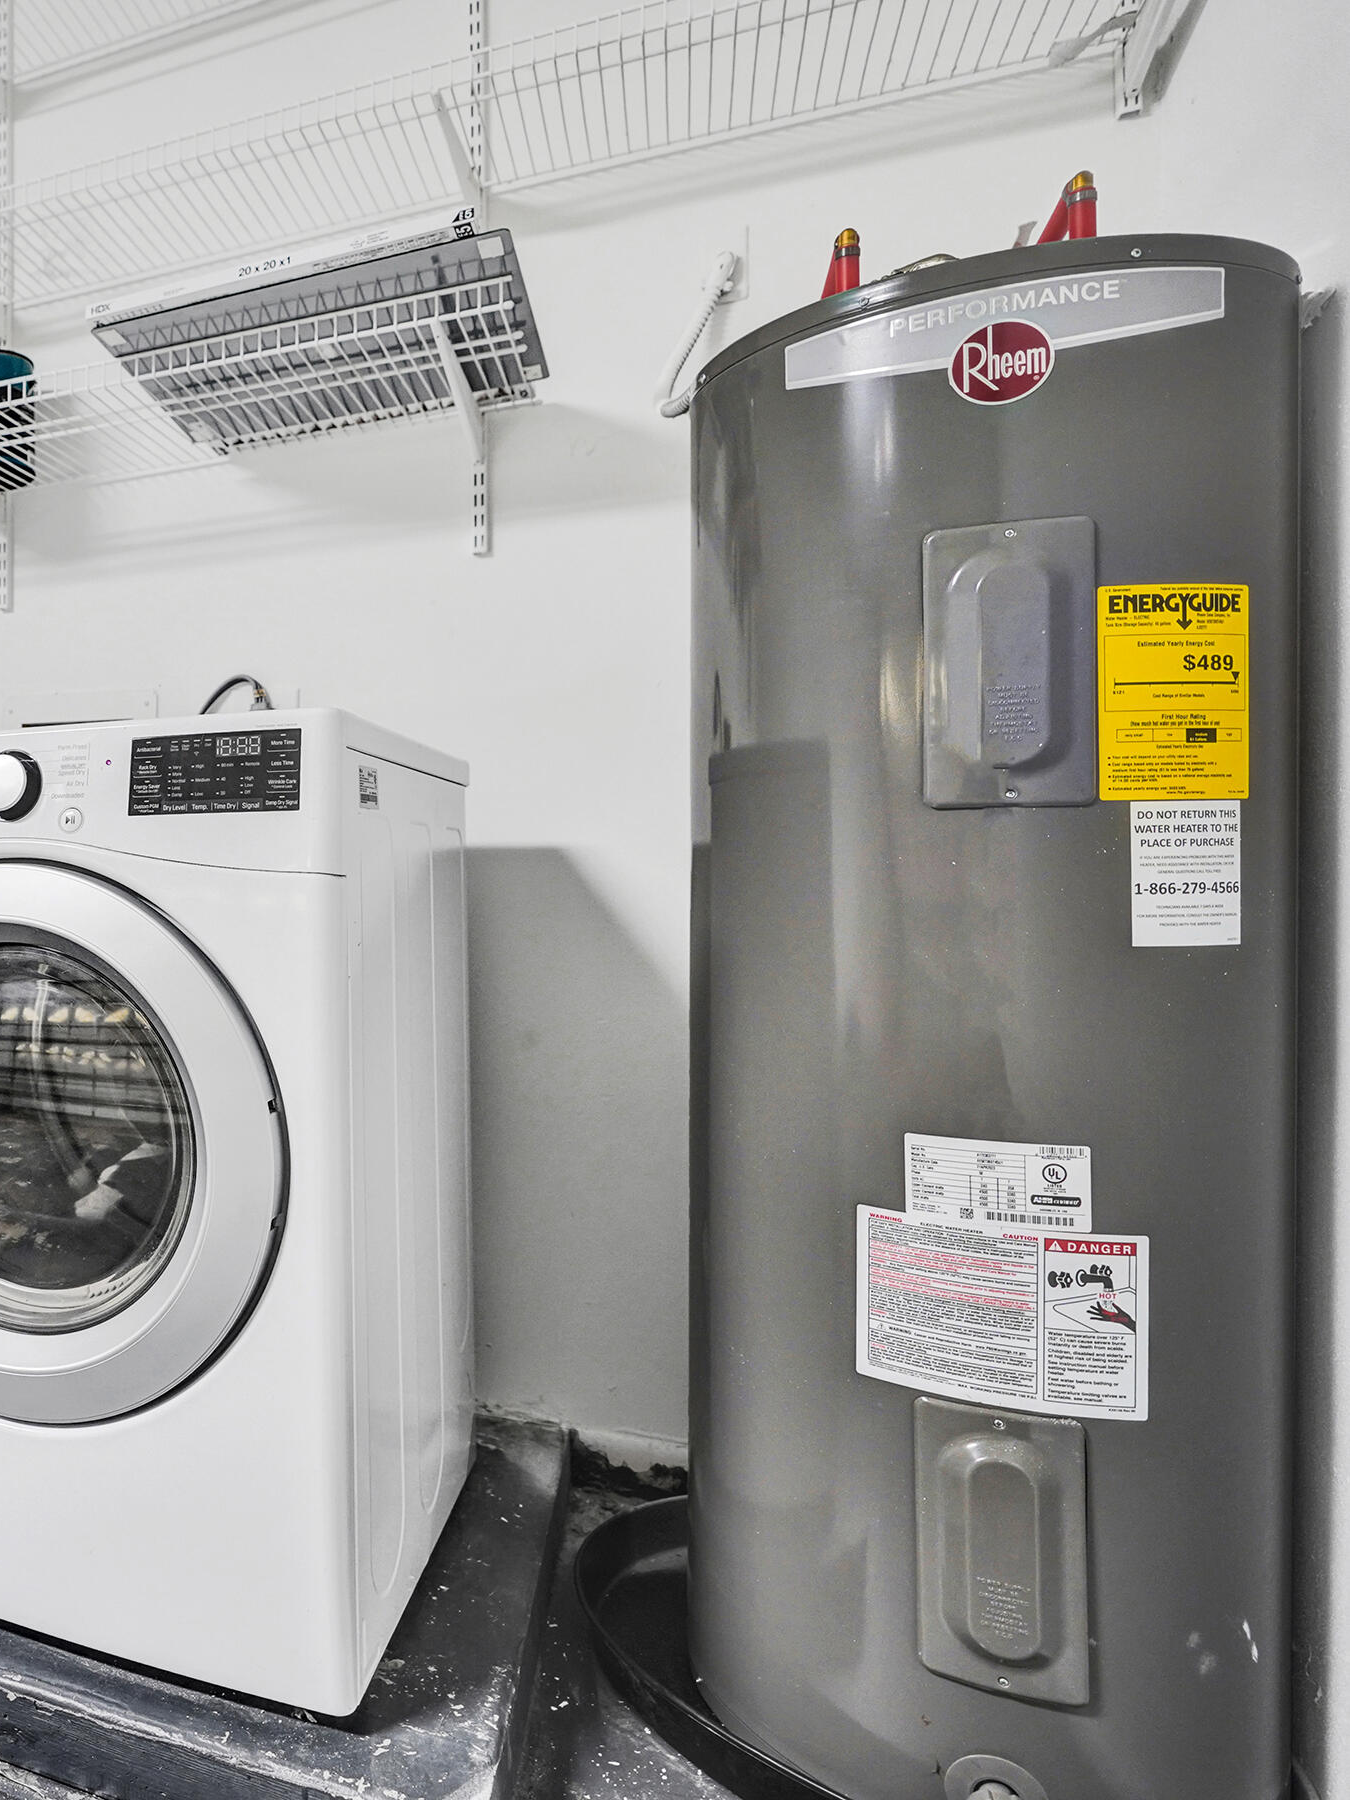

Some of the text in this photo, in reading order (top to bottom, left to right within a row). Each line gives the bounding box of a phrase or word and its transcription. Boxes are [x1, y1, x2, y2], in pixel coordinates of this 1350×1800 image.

[238, 265, 251, 277] 20
[263, 259, 276, 271] 20
[91, 303, 112, 315] HDX
[888, 279, 1121, 338] PERFORMANCE
[962, 325, 1047, 393] Rheem
[1108, 593, 1241, 614] ENERGYGUIDE
[1183, 654, 1233, 672] $489
[1138, 810, 1236, 819] DO NOT RETURN THIS
[1134, 824, 1238, 833] WATER HEATER TO THE
[1140, 838, 1234, 847] PLACE OF PURCHASE
[1134, 881, 1239, 895] 1-866-279-4566
[1048, 1168, 1061, 1180] UL
[870, 1213, 902, 1222] WARNING
[1067, 1242, 1131, 1254] DANGER
